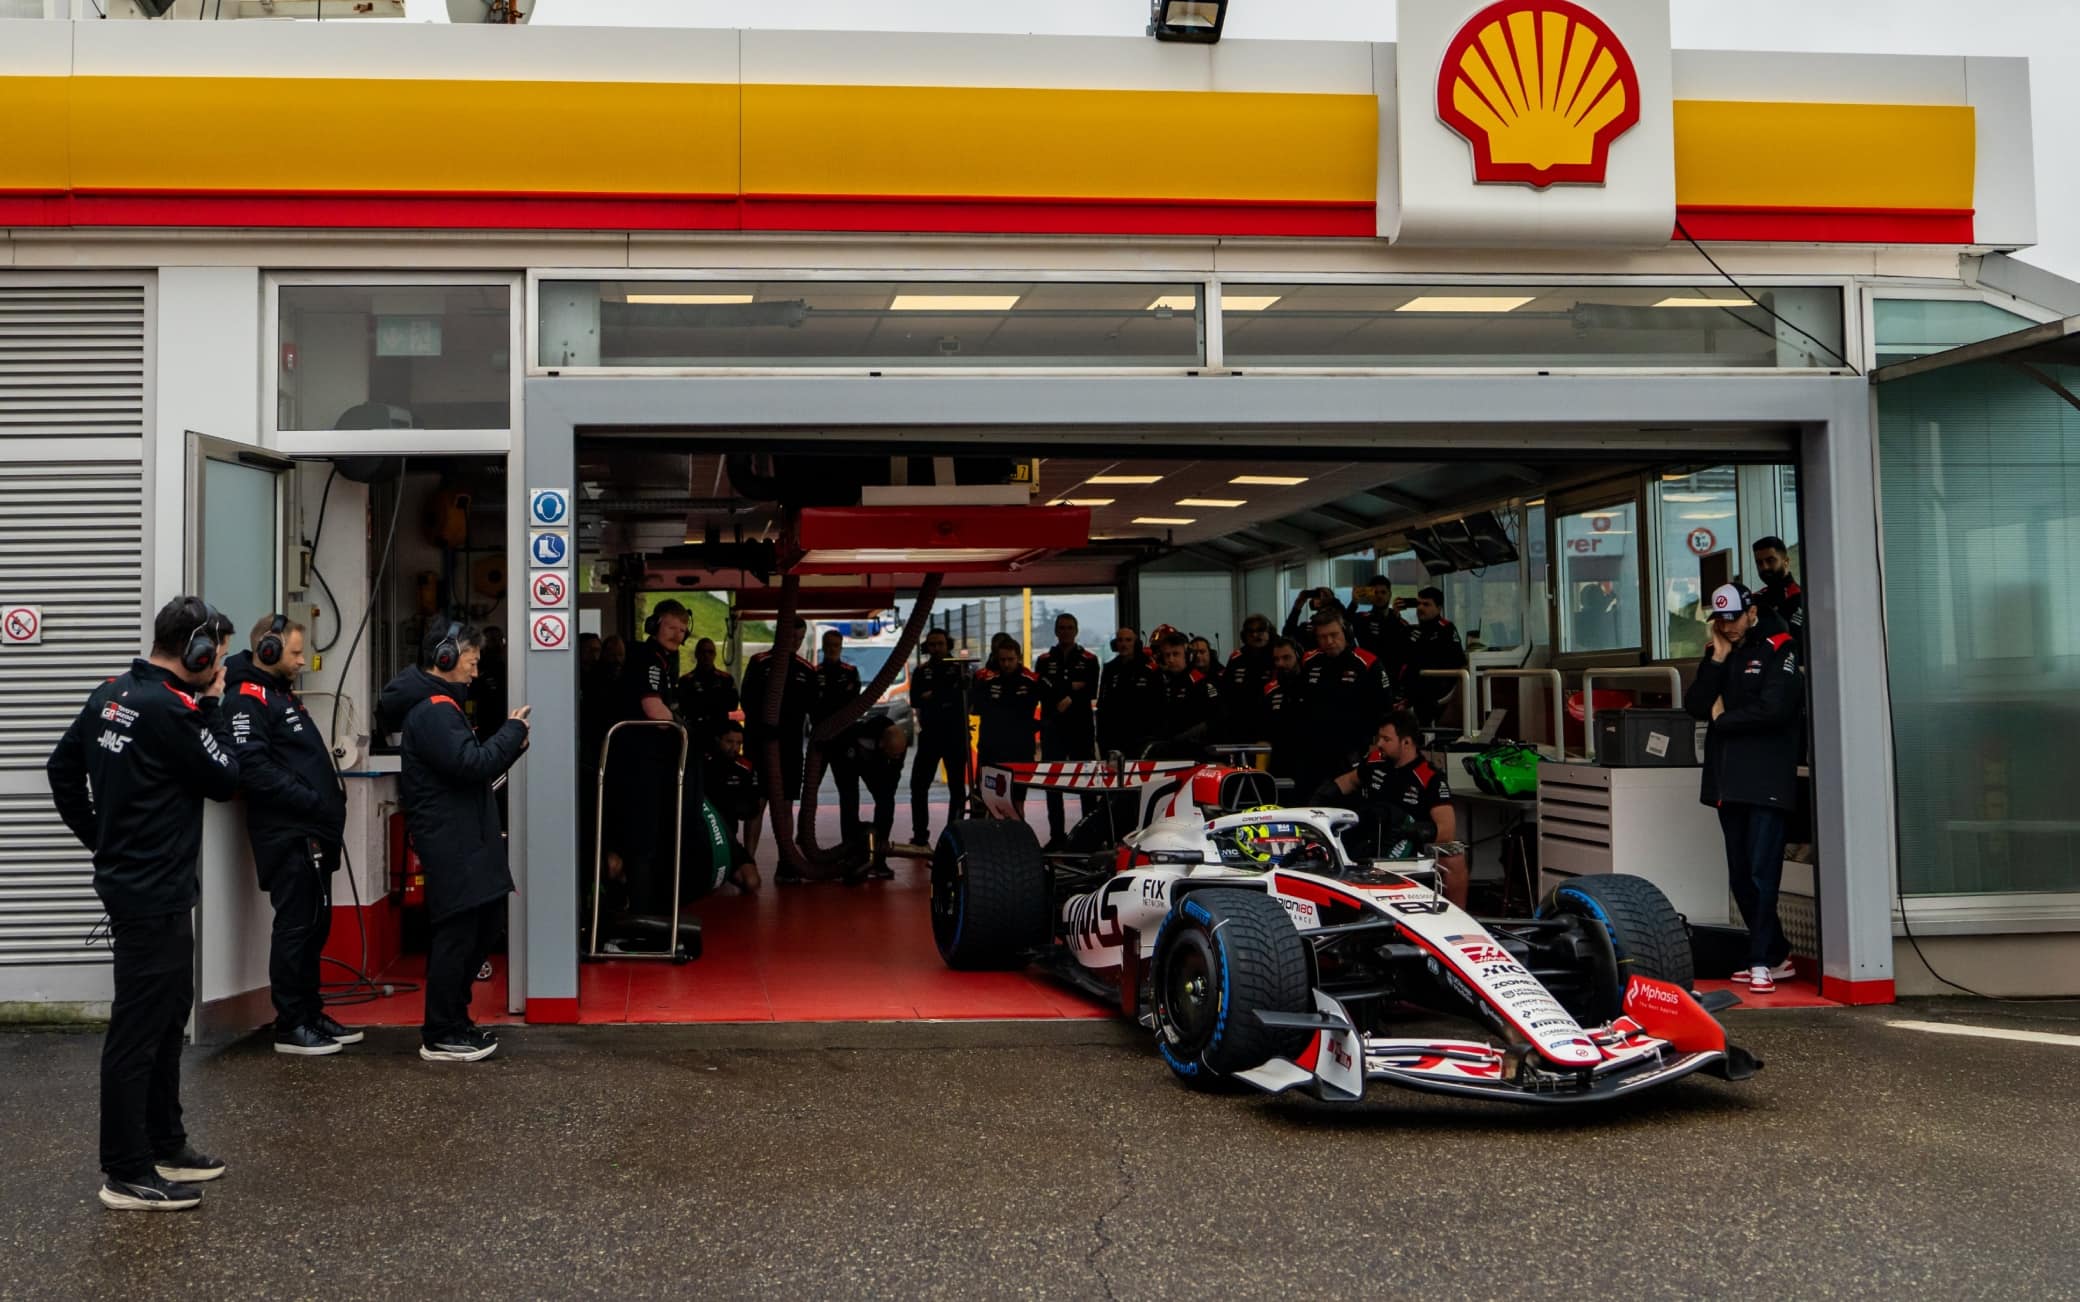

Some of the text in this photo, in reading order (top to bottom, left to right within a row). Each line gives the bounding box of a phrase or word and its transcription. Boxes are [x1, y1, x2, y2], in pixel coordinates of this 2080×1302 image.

[707, 813, 724, 846] FRONT
[1142, 879, 1166, 900] FIX
[1640, 983, 1679, 1005] Mphasis
